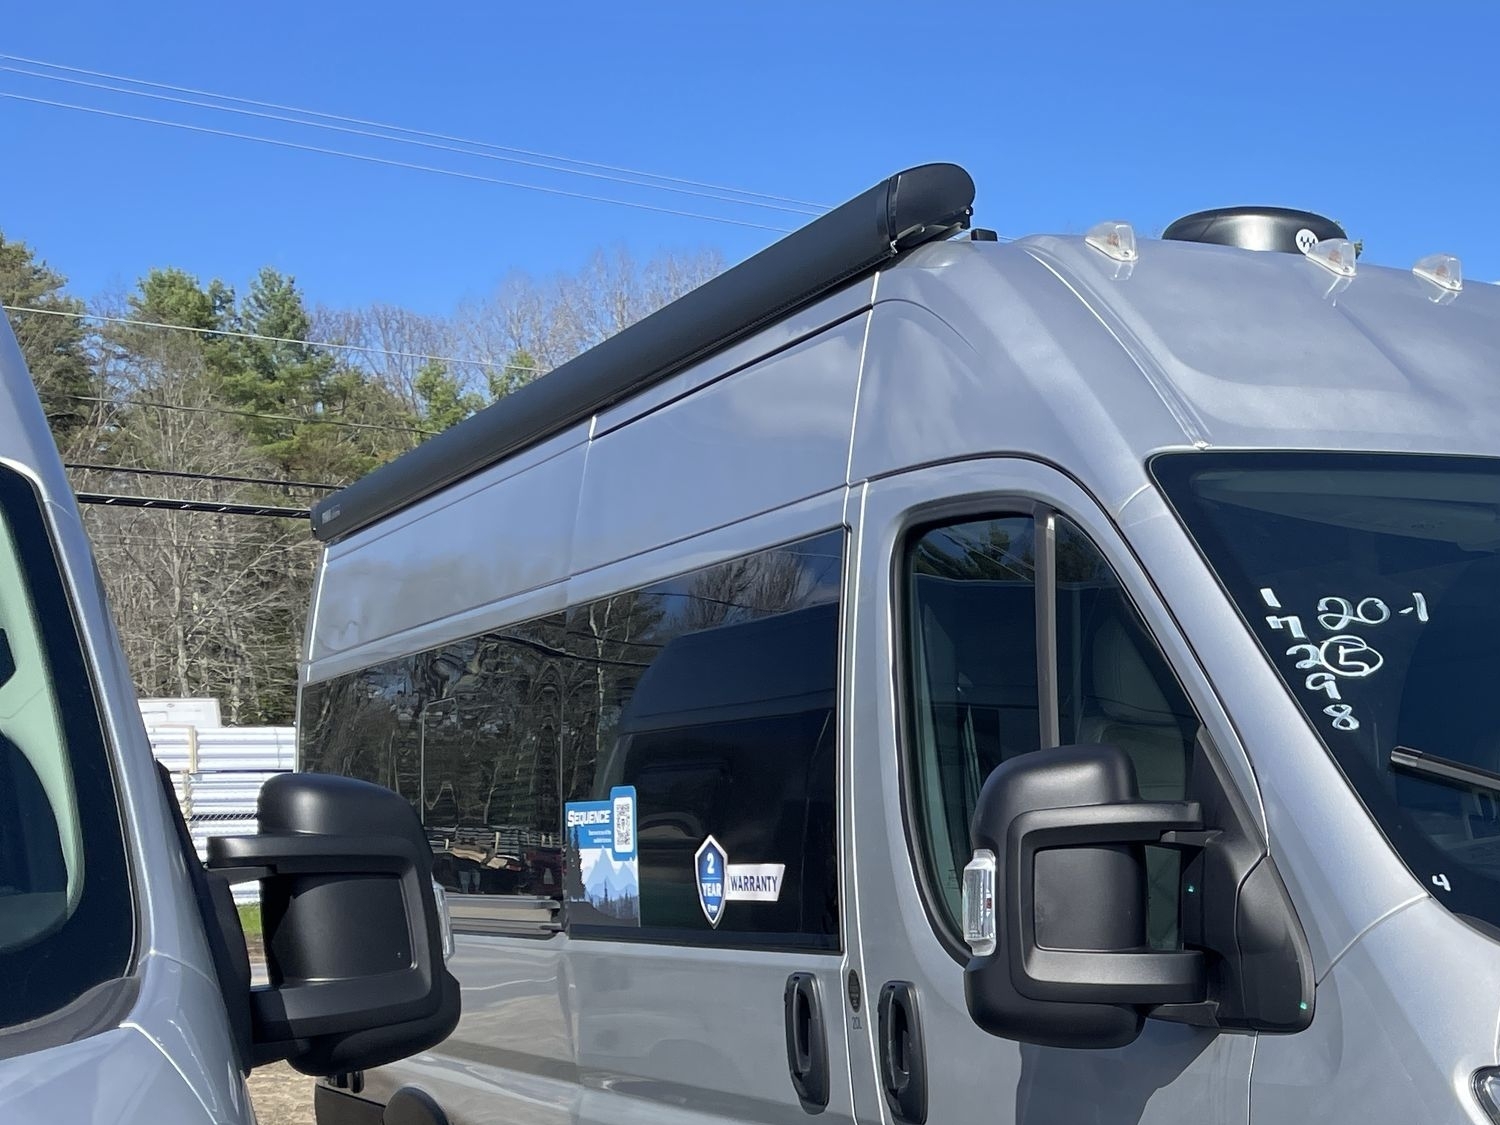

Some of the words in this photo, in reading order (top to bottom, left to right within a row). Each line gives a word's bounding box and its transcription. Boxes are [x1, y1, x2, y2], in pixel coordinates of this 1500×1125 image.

[706, 852, 715, 874] 2
[701, 882, 722, 897] YEAR
[730, 875, 778, 893] WARRANTY
[1432, 873, 1452, 892] 4
